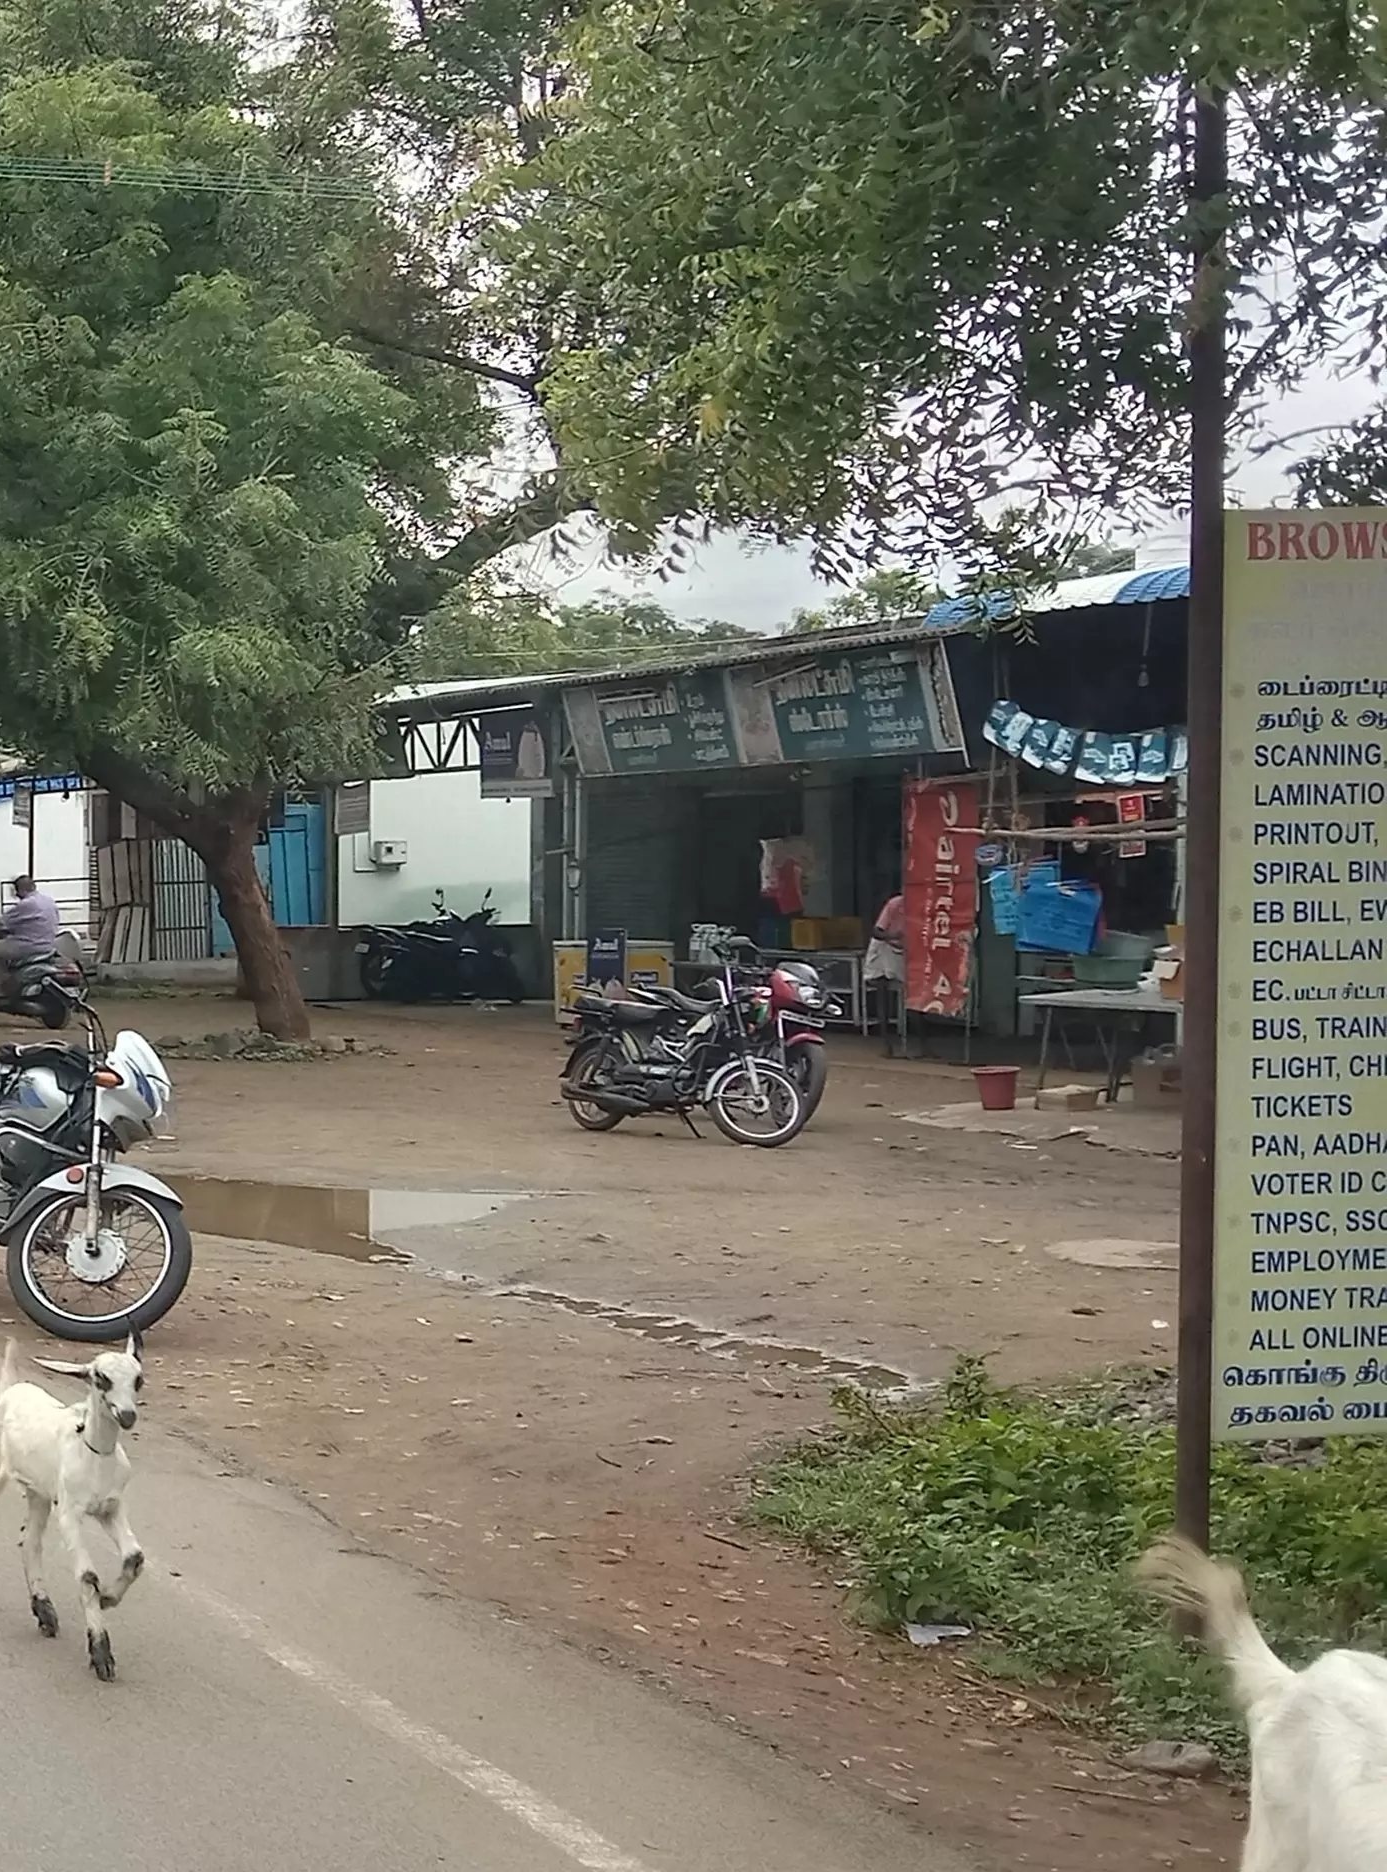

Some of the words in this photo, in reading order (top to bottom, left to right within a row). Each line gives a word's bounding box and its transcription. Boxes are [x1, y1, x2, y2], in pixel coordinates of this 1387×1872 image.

[1247, 521, 1387, 561] BROW
[1256, 706, 1324, 734] தமிழ்
[1331, 708, 1349, 727] &
[1254, 821, 1379, 847] PRINTOUT,
[1253, 862, 1340, 884] SPIRAL
[1253, 901, 1284, 924] EB
[1293, 900, 1352, 926] BILL,
[1253, 938, 1383, 963] ECHALLAN
[1253, 979, 1291, 1002] EC.
[1294, 986, 1337, 1001] பட்டா
[1252, 1017, 1308, 1043] BUS,
[1315, 1016, 1387, 1040] TRAIN
[1252, 1056, 1341, 1082] FLIGHT,
[1251, 1094, 1353, 1118] TICKETS
[1252, 1134, 1305, 1160] PAN,
[1251, 1172, 1332, 1196] VOTER
[1340, 1171, 1363, 1194] ID
[1251, 1210, 1338, 1236] TNPSC,
[1251, 1248, 1387, 1273] EMPLOYME
[1251, 1288, 1337, 1312] MONEY
[1249, 1328, 1295, 1351] ALL
[1303, 1325, 1387, 1349] ONLINE
[1223, 1358, 1346, 1388] கொங்கு
[1228, 1396, 1335, 1429] தகவல்
